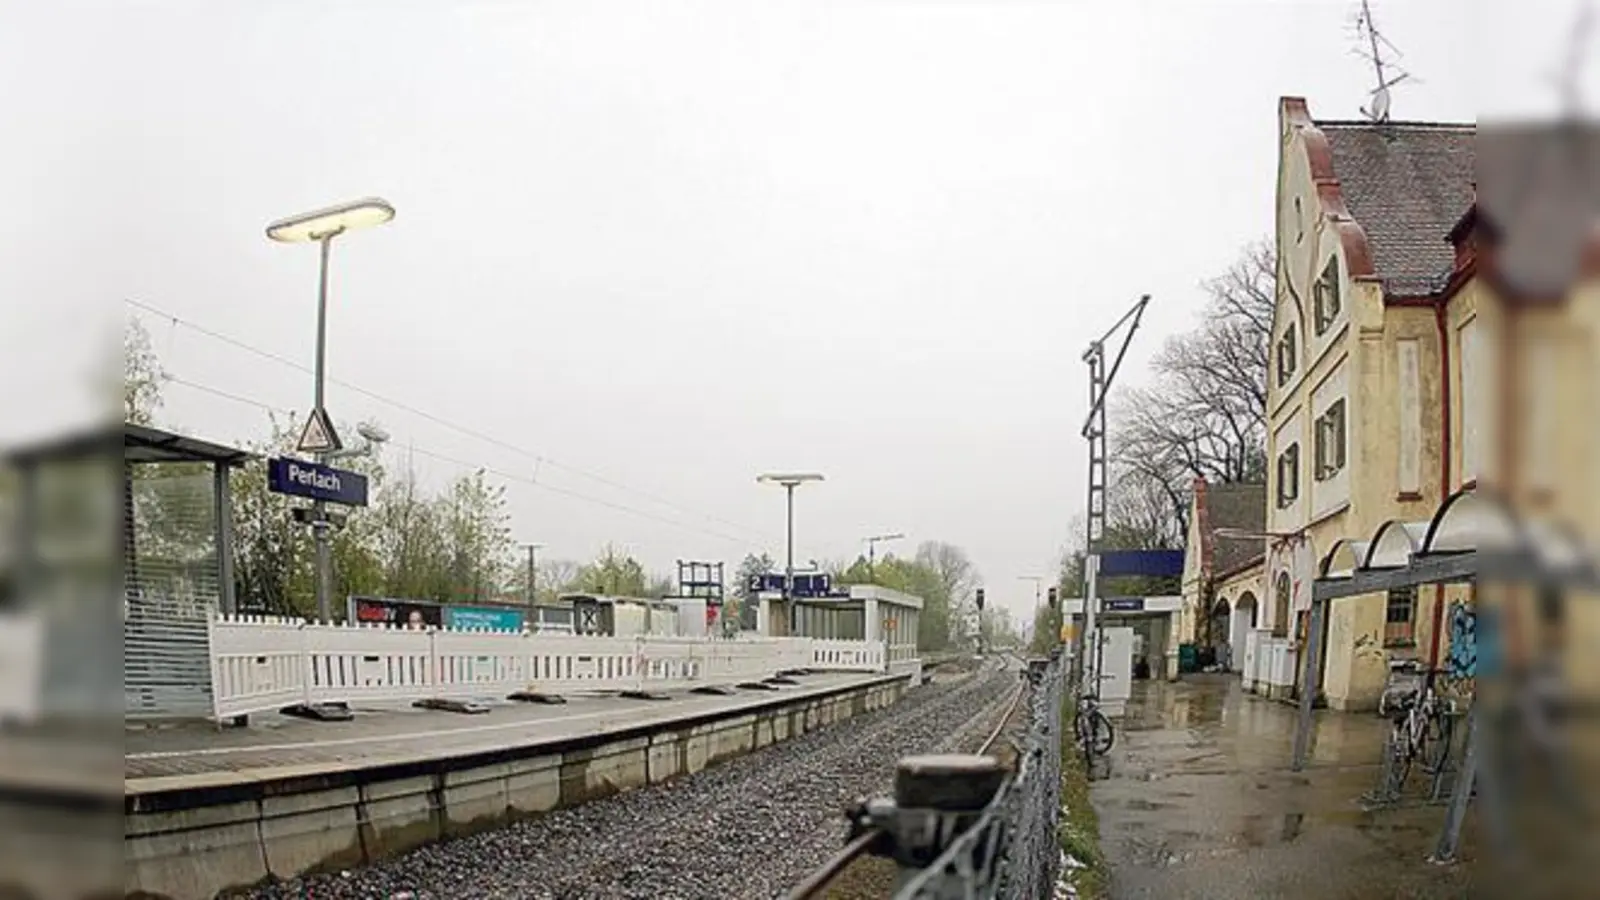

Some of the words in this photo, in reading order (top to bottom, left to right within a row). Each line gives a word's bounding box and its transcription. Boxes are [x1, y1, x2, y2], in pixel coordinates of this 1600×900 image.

[289, 464, 341, 491] Perlach
[752, 575, 761, 589] 2
[822, 576, 829, 588] 1
